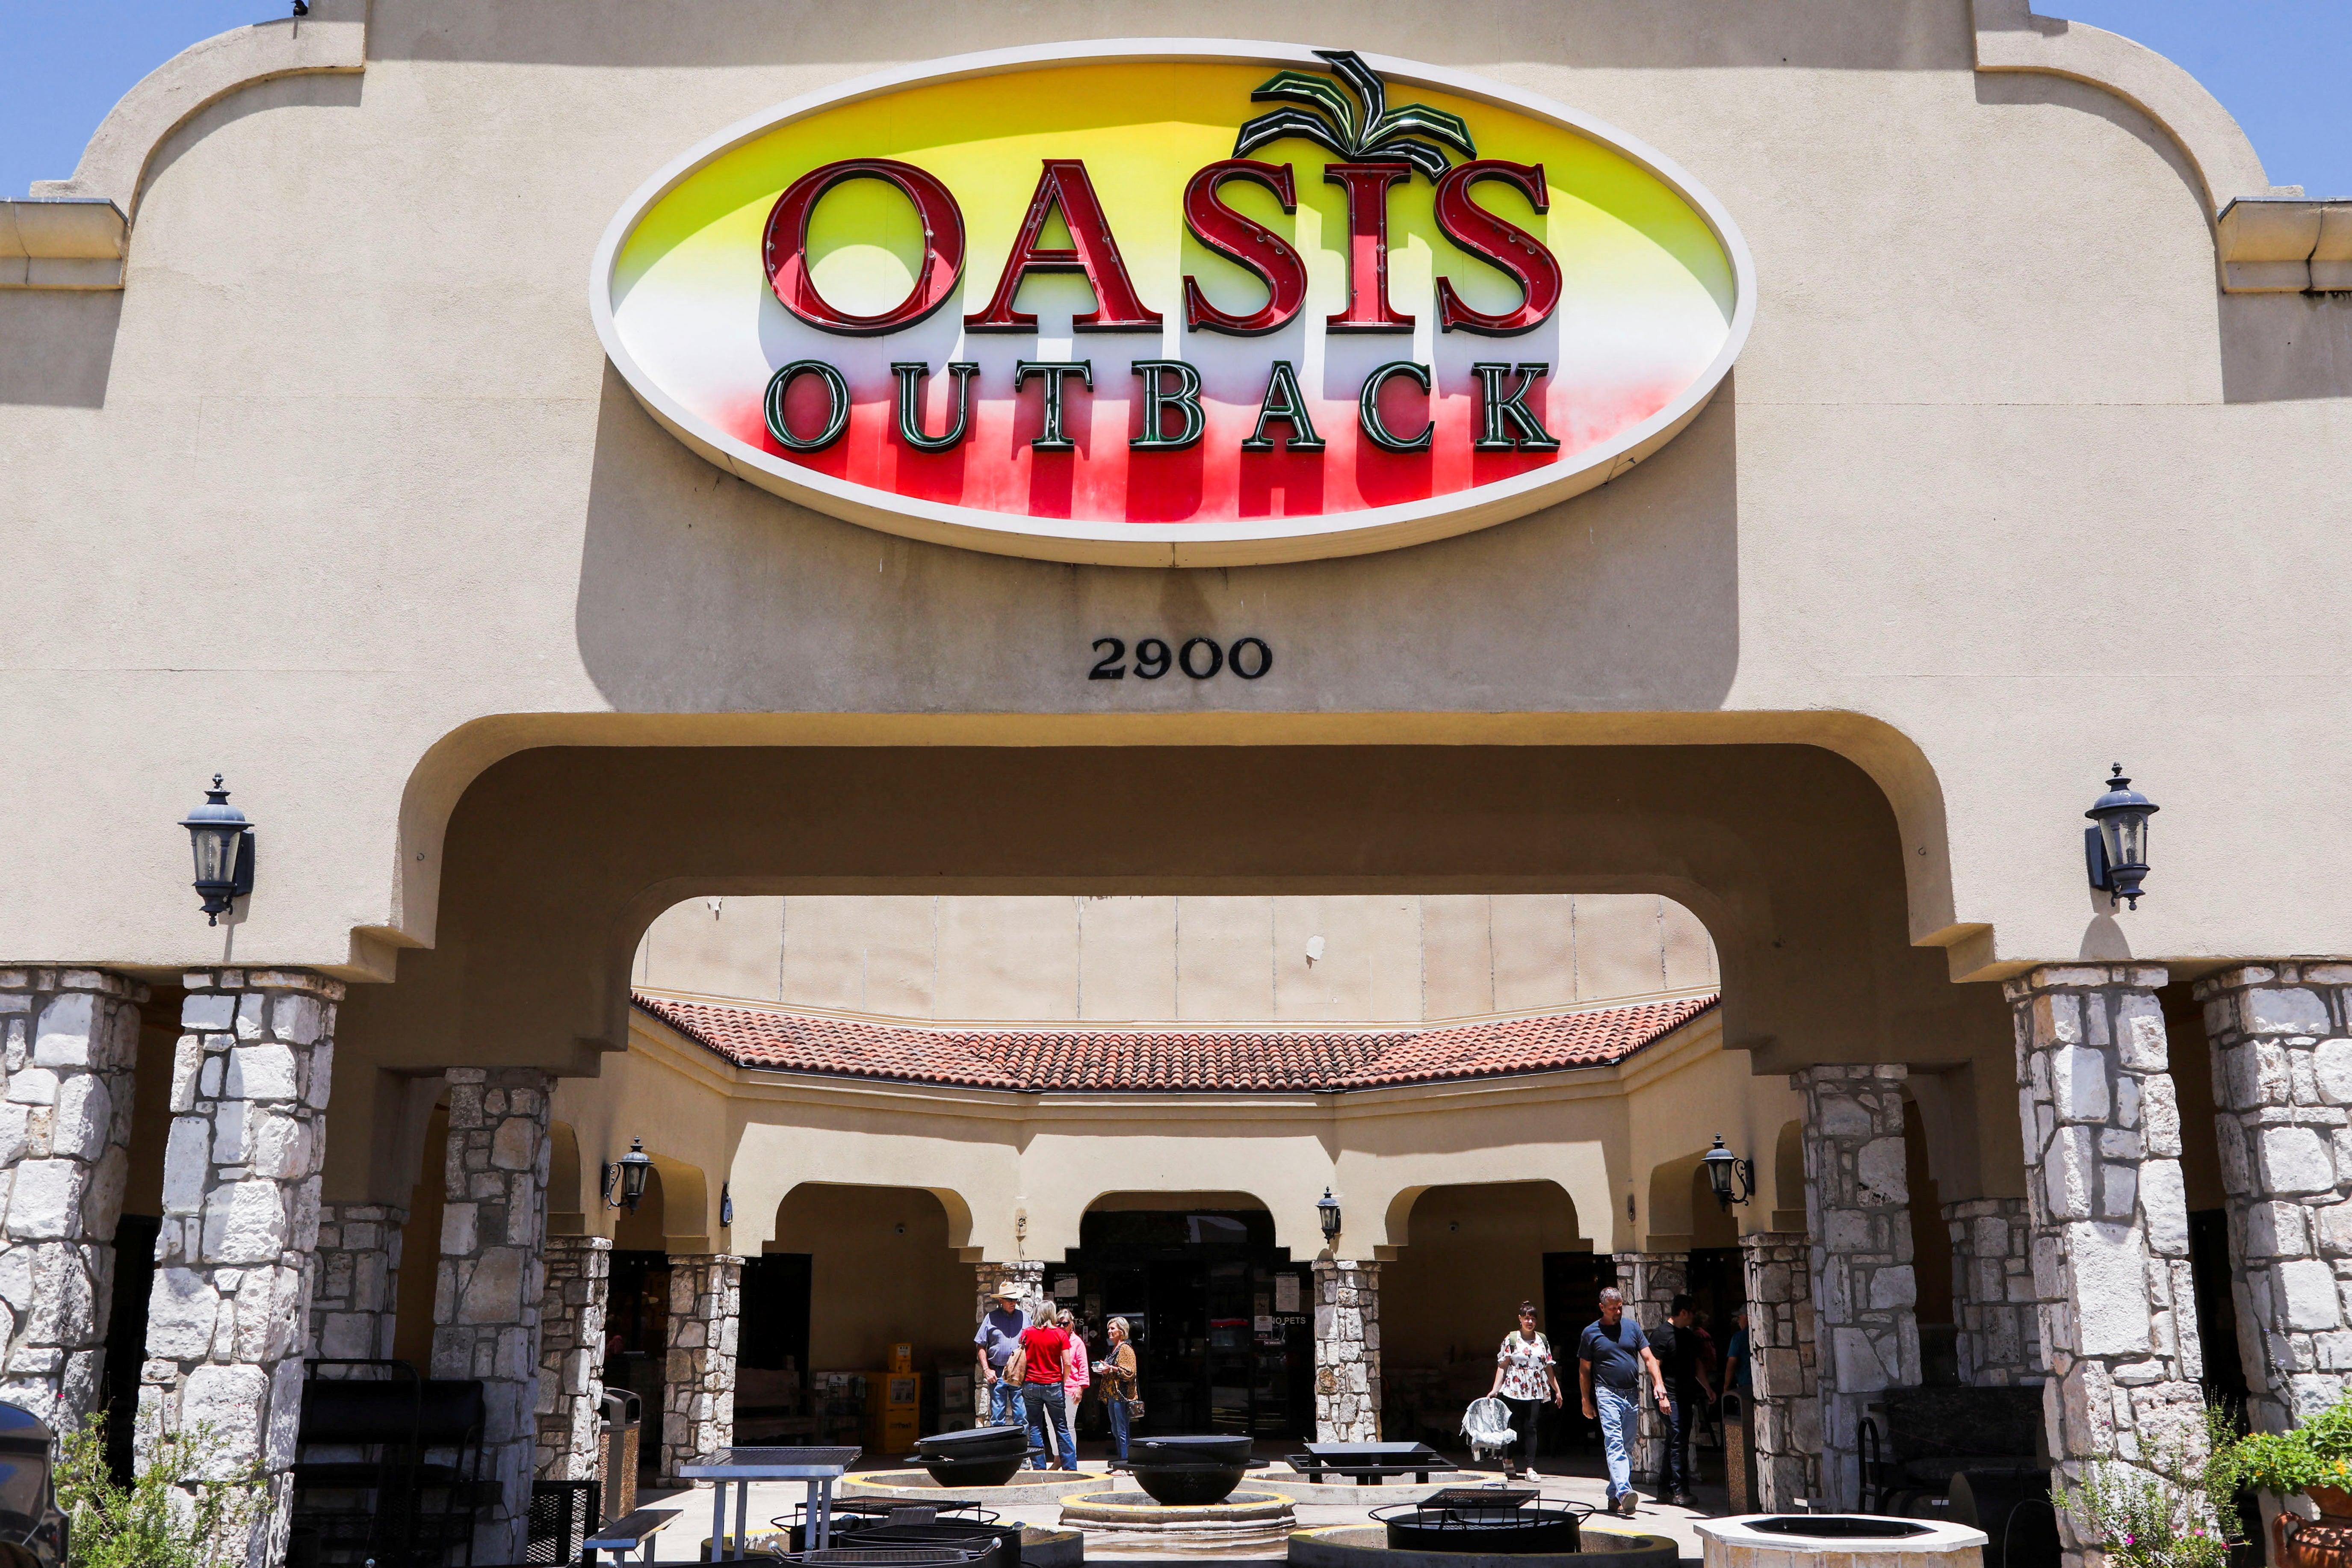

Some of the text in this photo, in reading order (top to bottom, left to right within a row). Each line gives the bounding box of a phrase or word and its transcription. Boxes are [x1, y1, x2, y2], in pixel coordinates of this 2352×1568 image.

[761, 158, 1563, 337] OASIS
[763, 359, 1561, 453] OUTBACK
[1088, 637, 1273, 680] 2900
